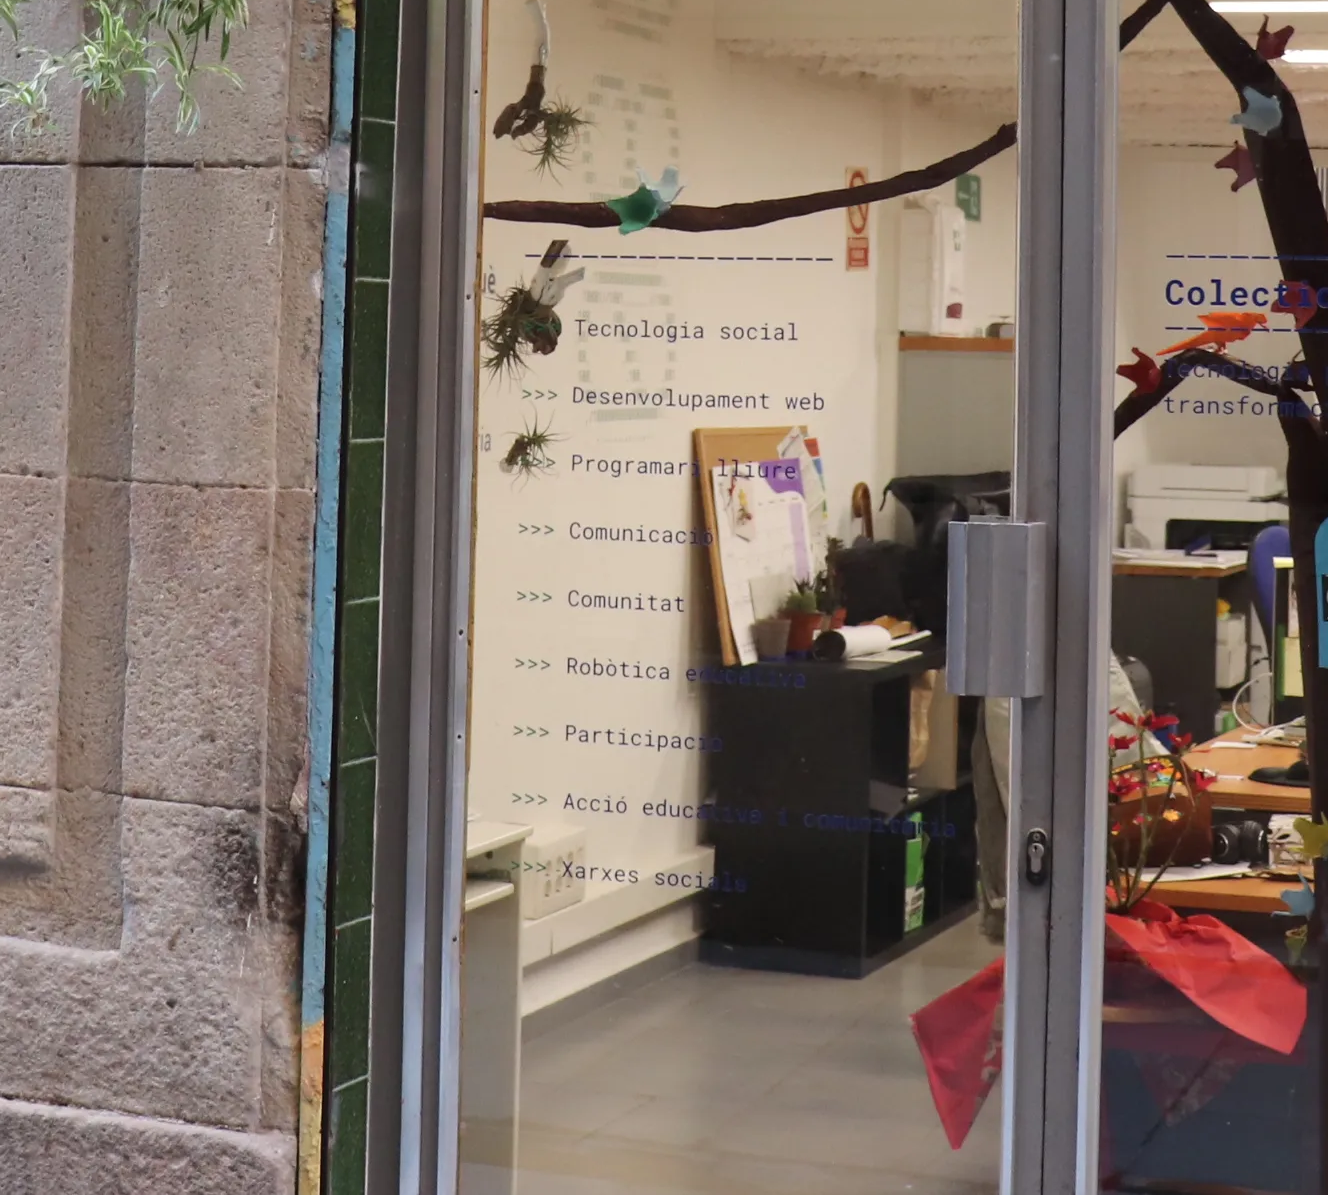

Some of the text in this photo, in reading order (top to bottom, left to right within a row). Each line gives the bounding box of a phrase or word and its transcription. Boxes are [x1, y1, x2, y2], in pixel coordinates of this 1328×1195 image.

[575, 318, 799, 343] Tecnologia social
[1164, 360, 1309, 386] Tecnologia
[572, 386, 825, 412] Desenvolupament web
[570, 454, 797, 480] Programari lliure
[568, 521, 714, 546] Comunicació
[567, 589, 685, 613] Comunitat
[566, 657, 670, 681] Robòtica
[563, 792, 627, 815] Acció
[561, 861, 639, 884] Xarxes
